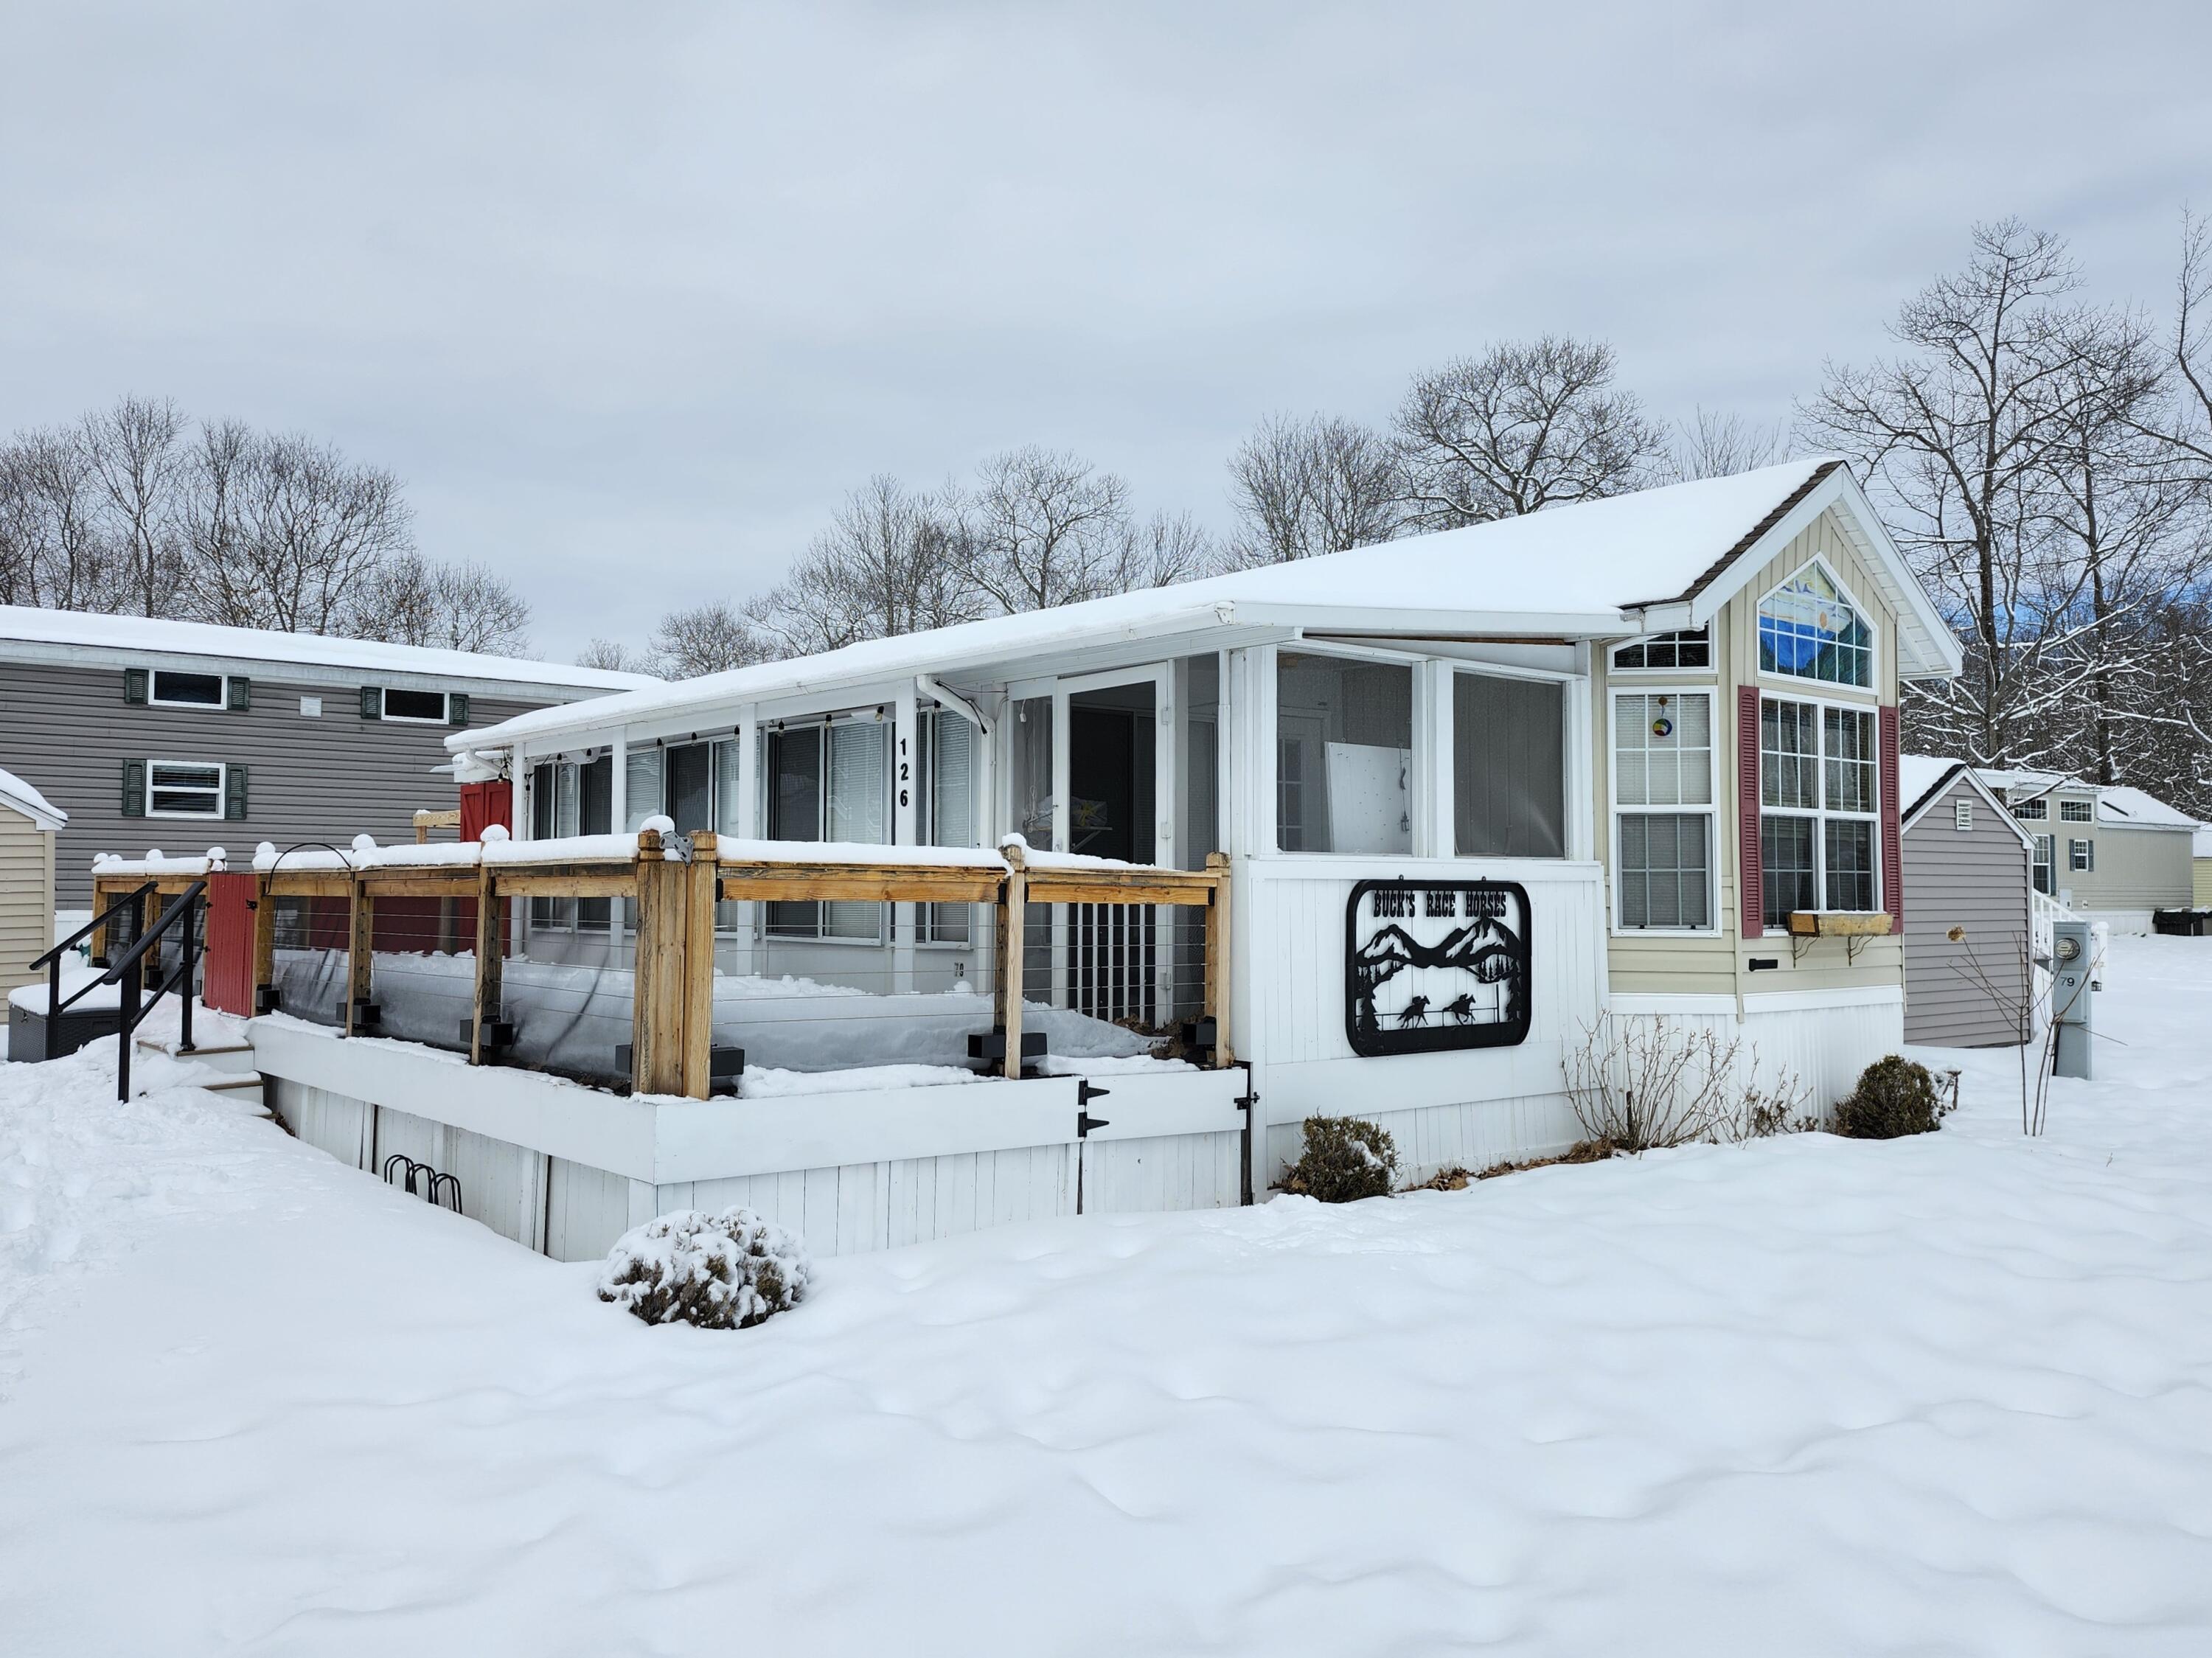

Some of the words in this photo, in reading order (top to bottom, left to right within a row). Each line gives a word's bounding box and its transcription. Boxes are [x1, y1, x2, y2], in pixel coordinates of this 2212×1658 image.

[900, 738, 909, 807] 126
[1374, 893, 1416, 918] BUCK'S
[1426, 893, 1455, 918] RACE
[1465, 894, 1507, 918] HORSES
[2060, 977, 2075, 987] 79
